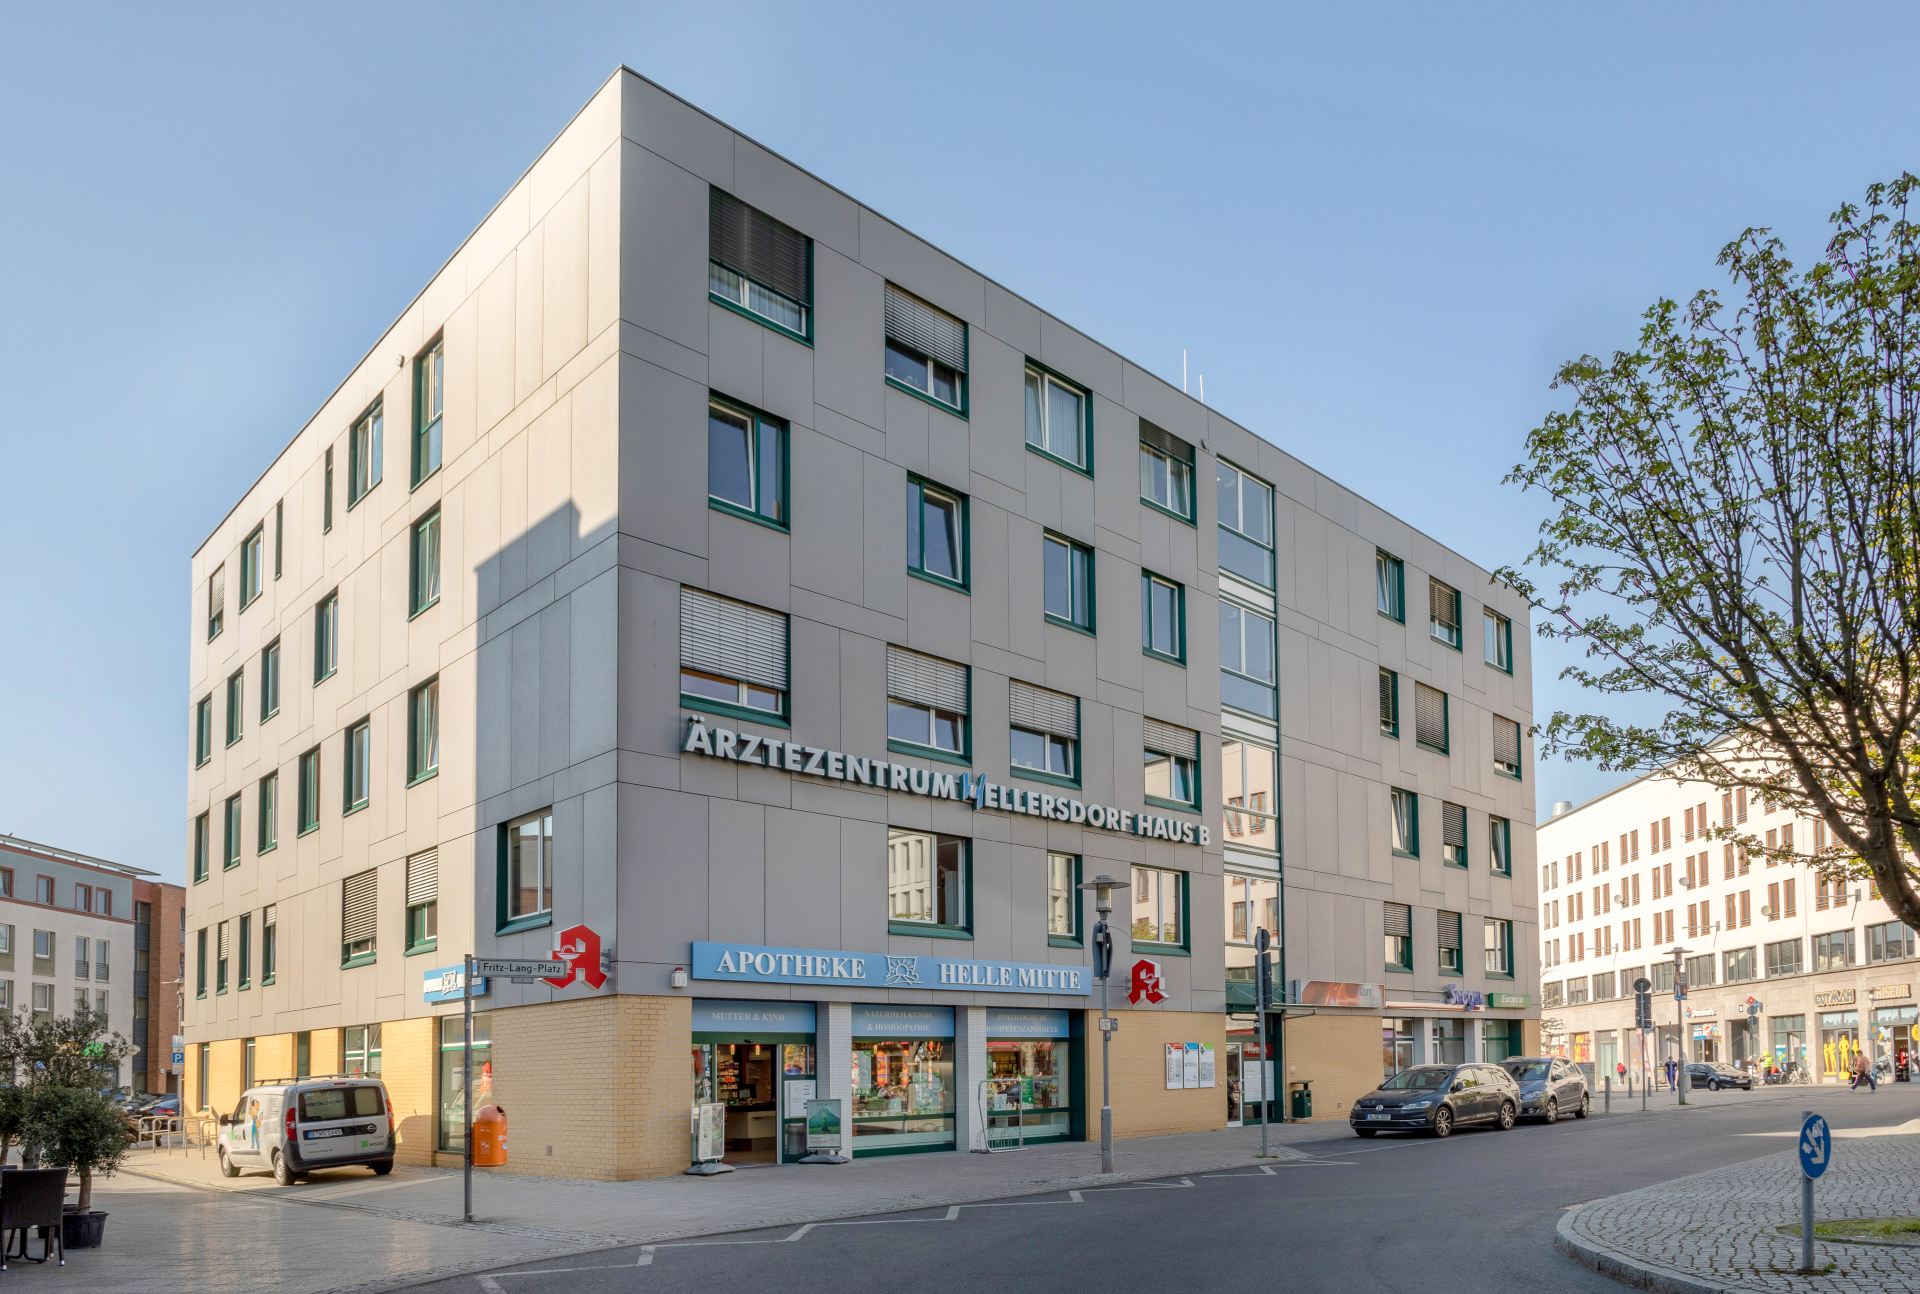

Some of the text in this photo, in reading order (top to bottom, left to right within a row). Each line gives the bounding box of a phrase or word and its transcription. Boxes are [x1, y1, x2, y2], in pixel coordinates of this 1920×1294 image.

[685, 715, 1211, 846] ÄRZTEZENTRUM HELLERSDORF HAUS B
[483, 962, 562, 975] Fritz-Lang-Platz
[714, 950, 866, 980] APOTHEKE
[939, 963, 1081, 990] HELLE MITTE
[712, 1011, 785, 1022] MUTTER & KIND
[174, 1053, 183, 1063] P
